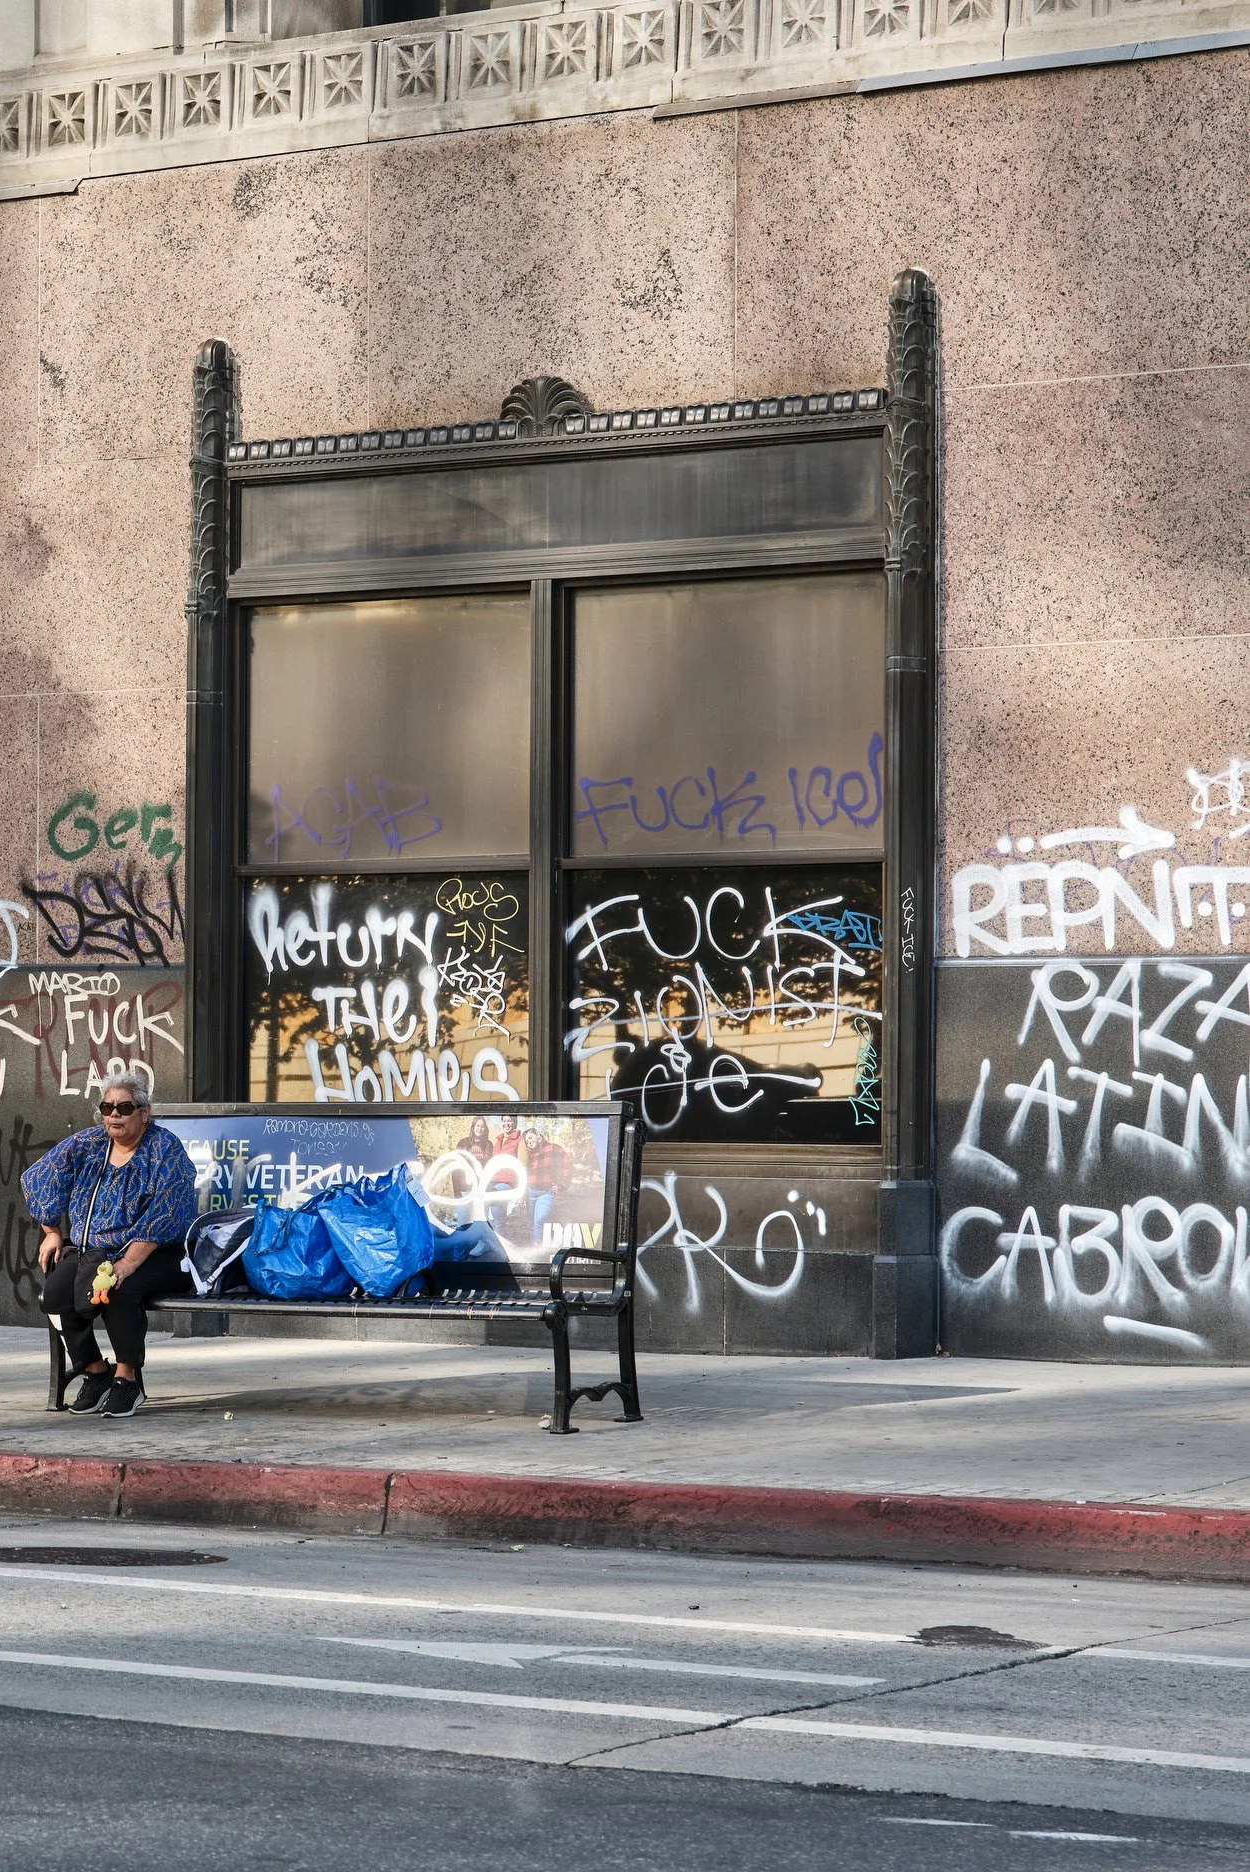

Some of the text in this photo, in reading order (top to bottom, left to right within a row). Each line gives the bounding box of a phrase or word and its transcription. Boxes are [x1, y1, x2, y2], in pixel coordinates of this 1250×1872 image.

[575, 766, 777, 852] FUCK
[565, 886, 857, 972] FUCK
[901, 887, 915, 935] FUCK
[64, 994, 184, 1055] FUCK
[565, 945, 866, 1063] ZIONIST
[195, 1164, 235, 1189] ERY
